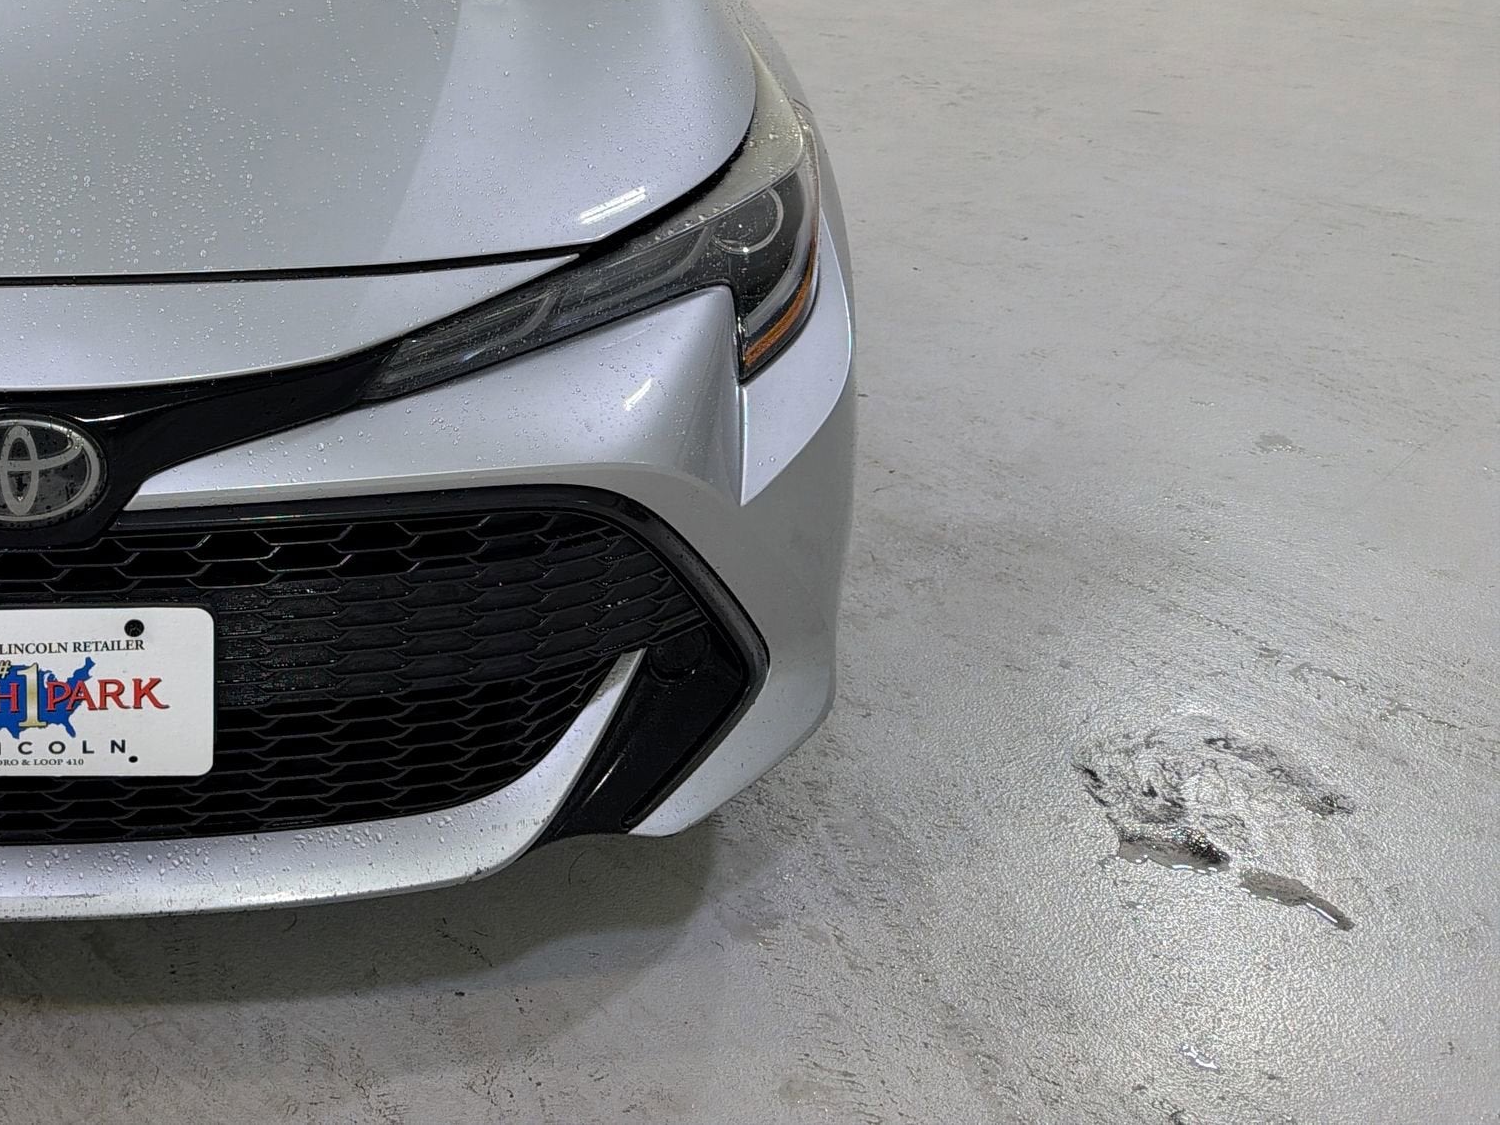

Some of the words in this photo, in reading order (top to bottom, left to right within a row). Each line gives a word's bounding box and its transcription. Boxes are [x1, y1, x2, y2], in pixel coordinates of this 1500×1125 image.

[0, 642, 68, 655] LINCOLN
[73, 639, 145, 653] RETAILER
[46, 677, 170, 711] PARK
[34, 758, 63, 766] LOOP
[66, 758, 84, 766] 410
